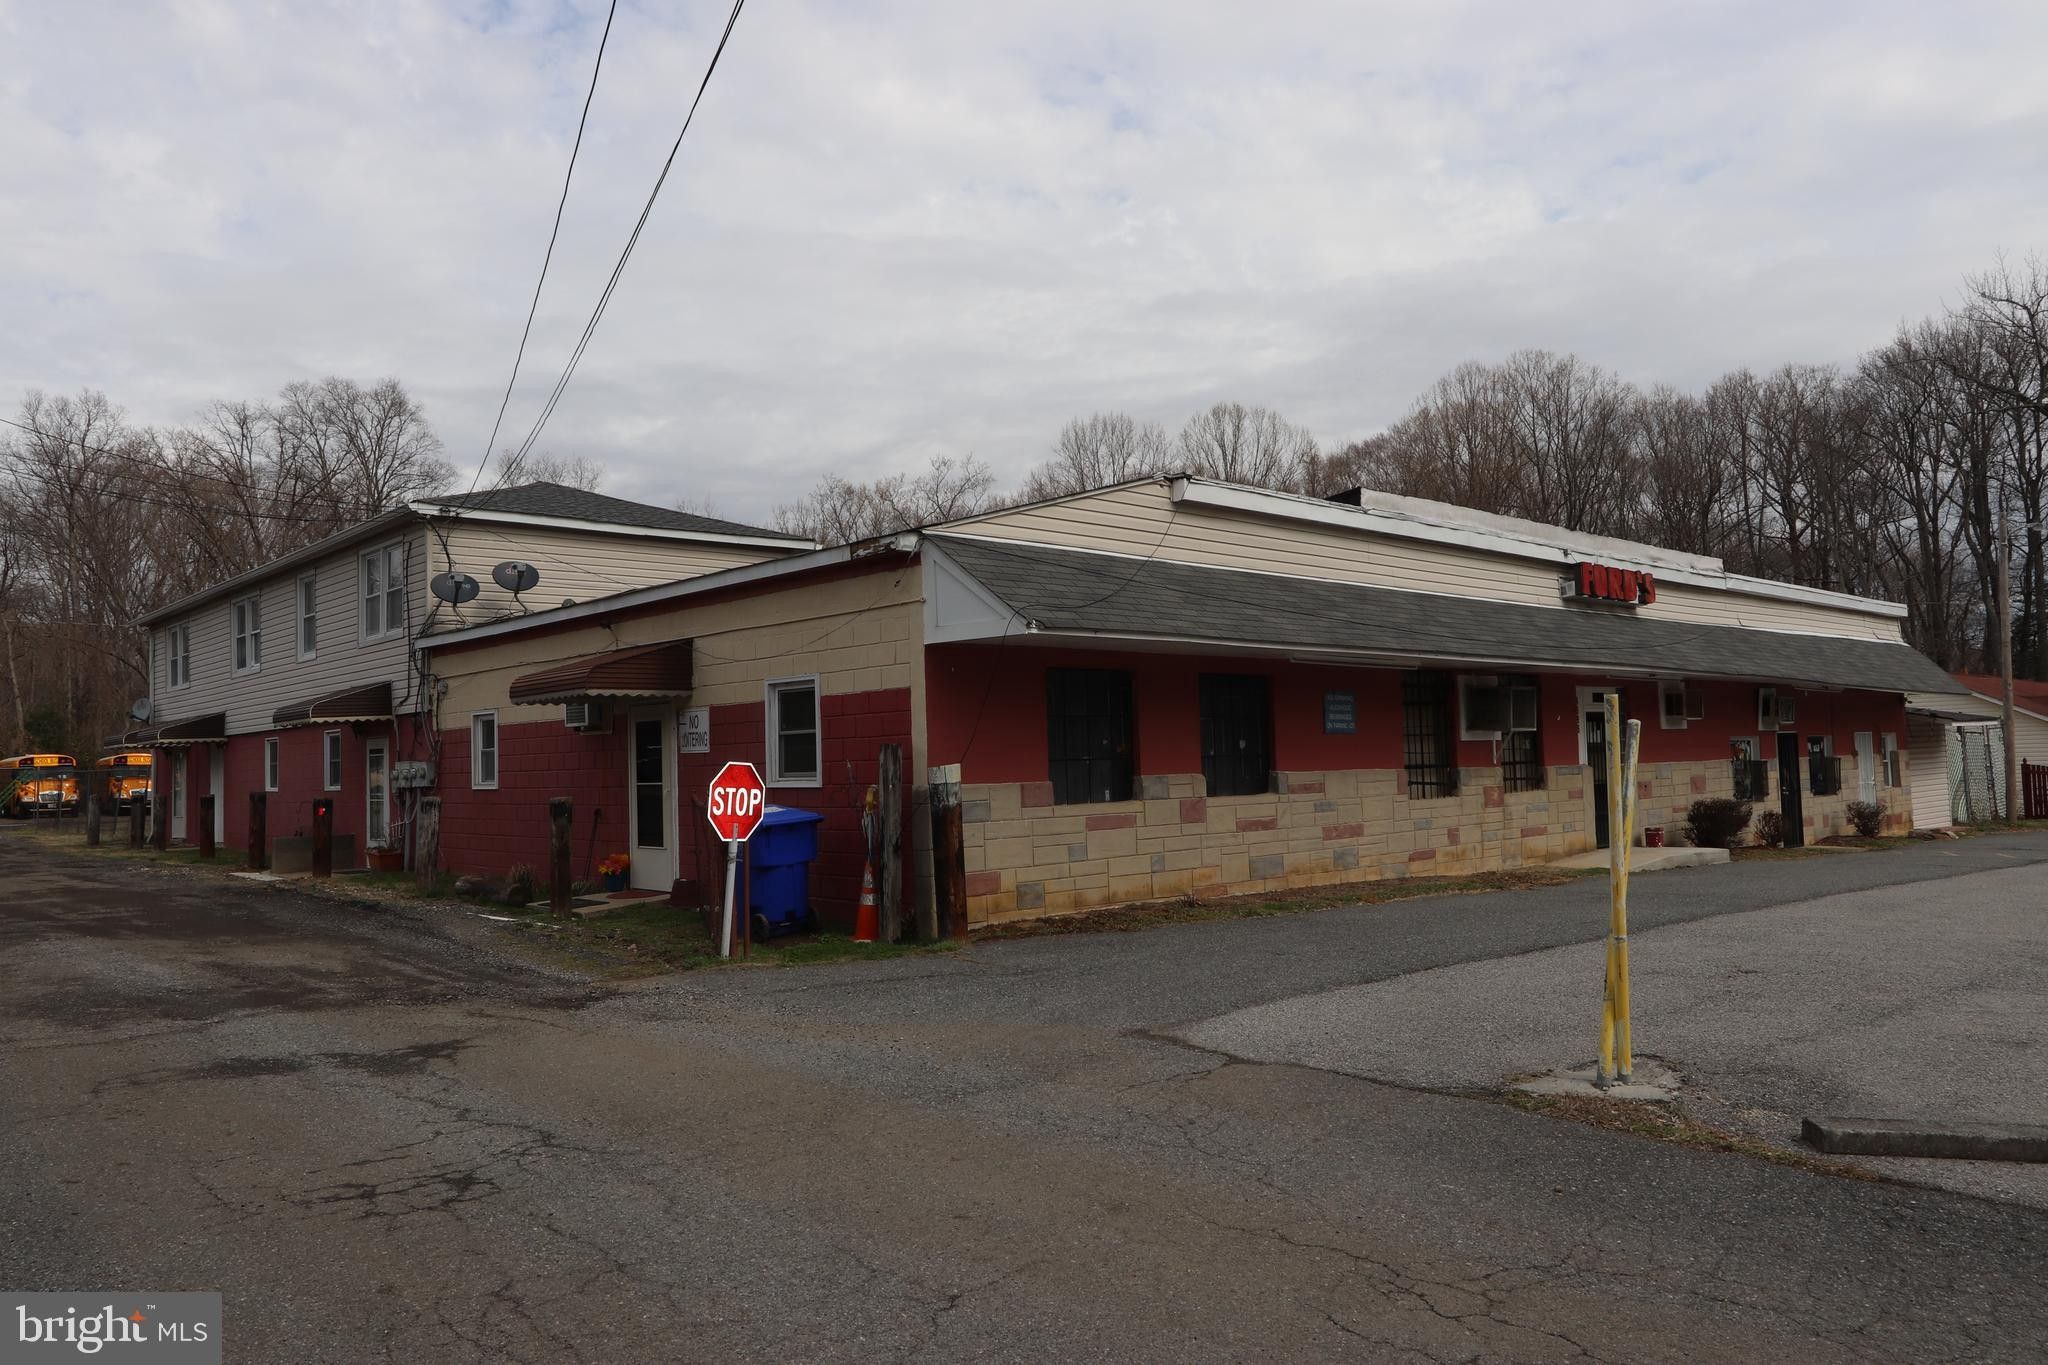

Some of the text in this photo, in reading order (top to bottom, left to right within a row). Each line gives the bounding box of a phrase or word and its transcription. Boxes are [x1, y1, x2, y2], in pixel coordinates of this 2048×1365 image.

[1579, 562, 1656, 604] FORD'S
[688, 714, 699, 729] NO
[712, 786, 762, 816] STOP
